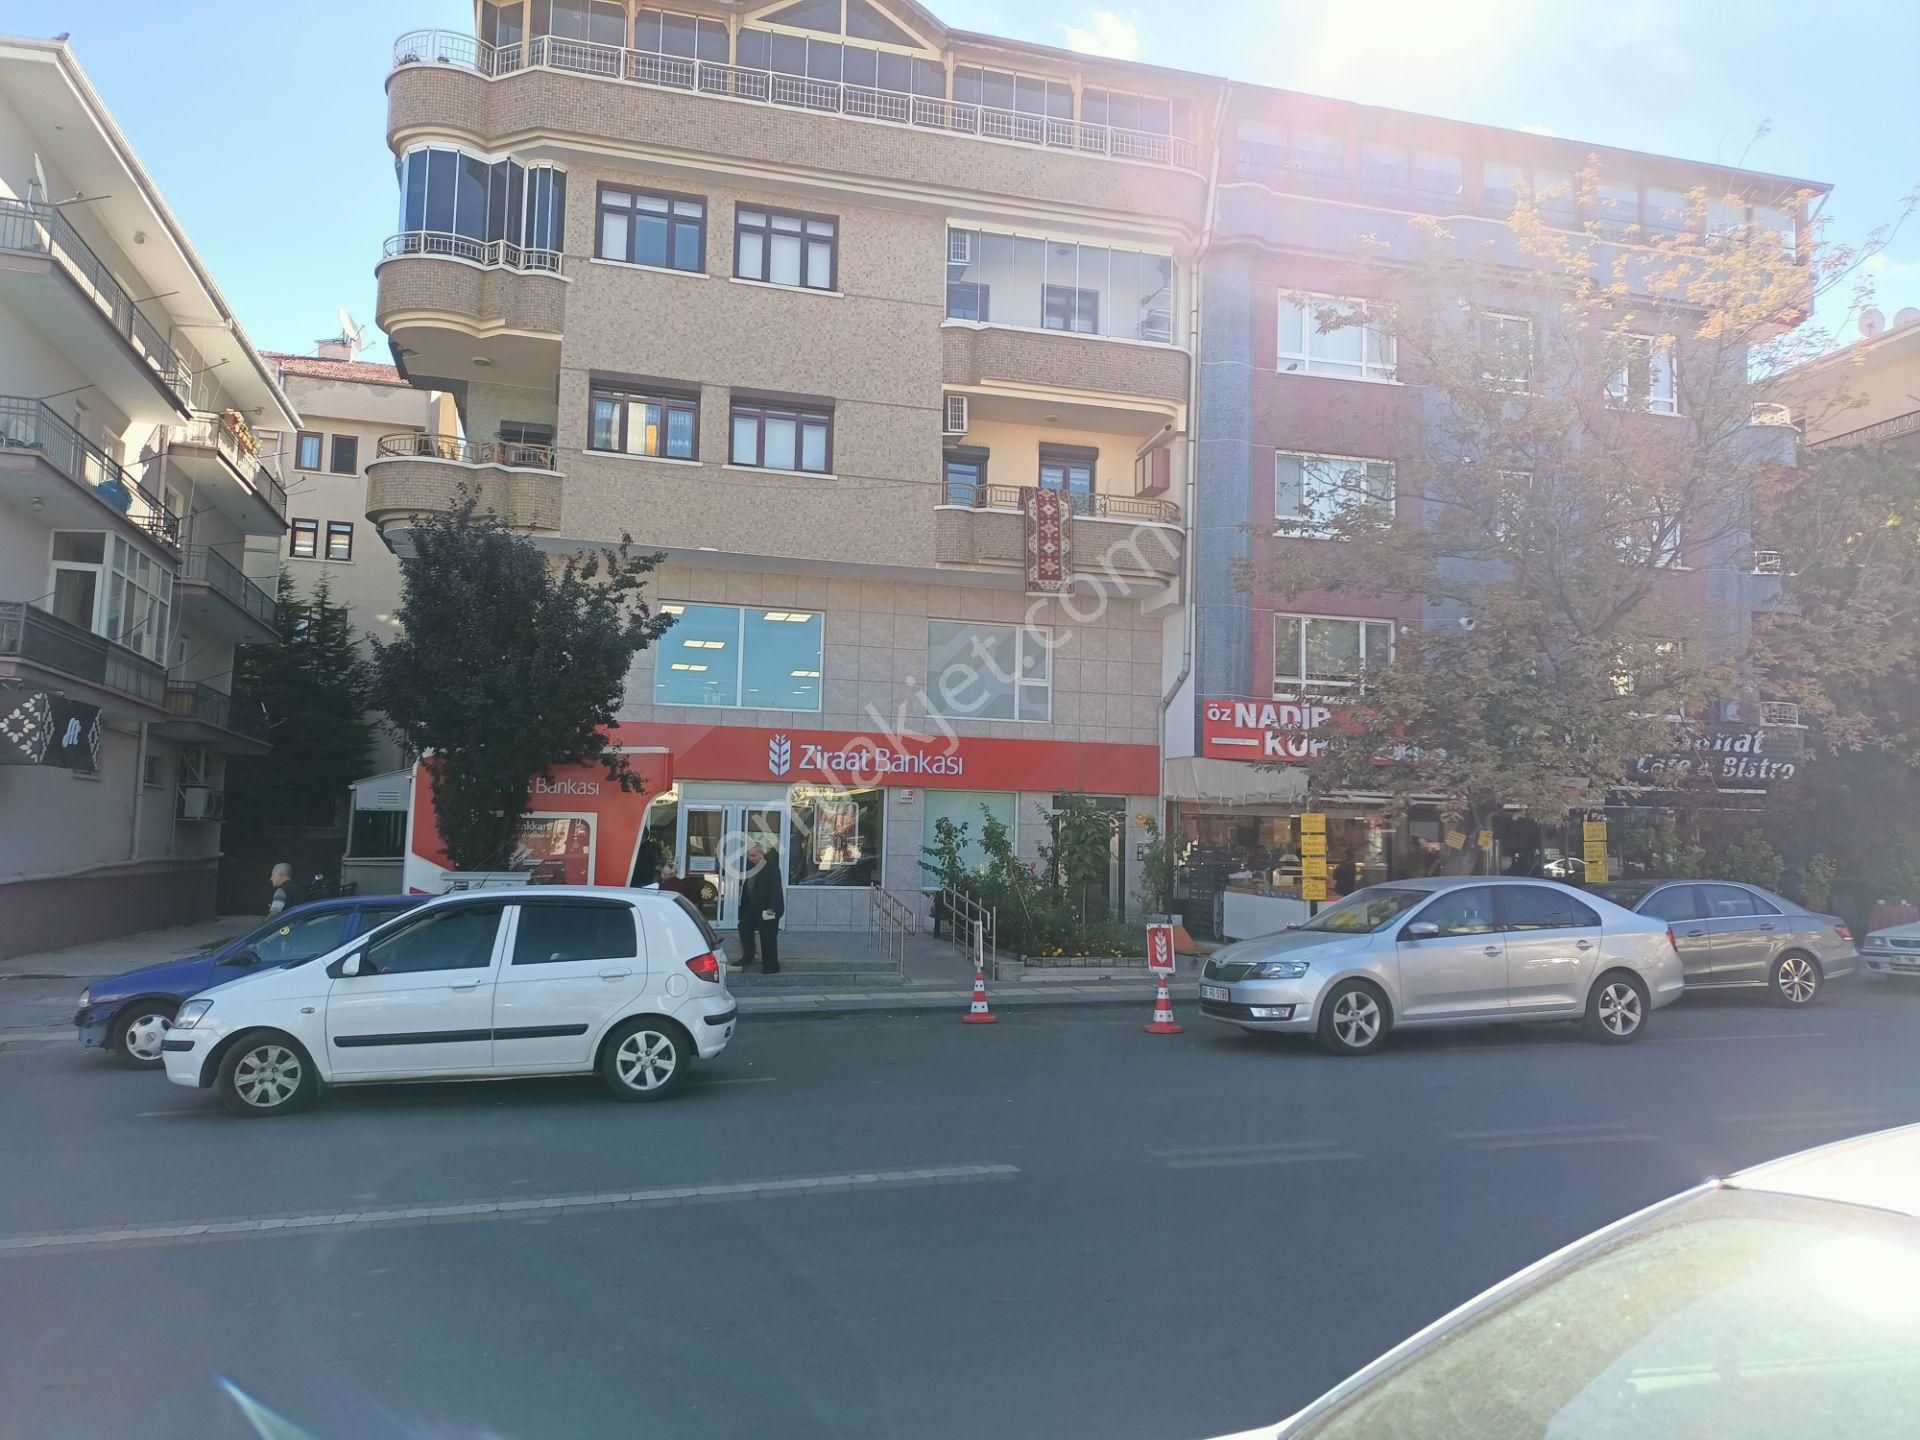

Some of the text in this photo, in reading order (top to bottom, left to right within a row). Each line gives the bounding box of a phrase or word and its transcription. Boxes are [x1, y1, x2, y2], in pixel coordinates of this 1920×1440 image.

[799, 744, 963, 775] Ziraat Bankası
[1722, 756, 1796, 780] Bistro
[536, 776, 600, 796] Bankası
